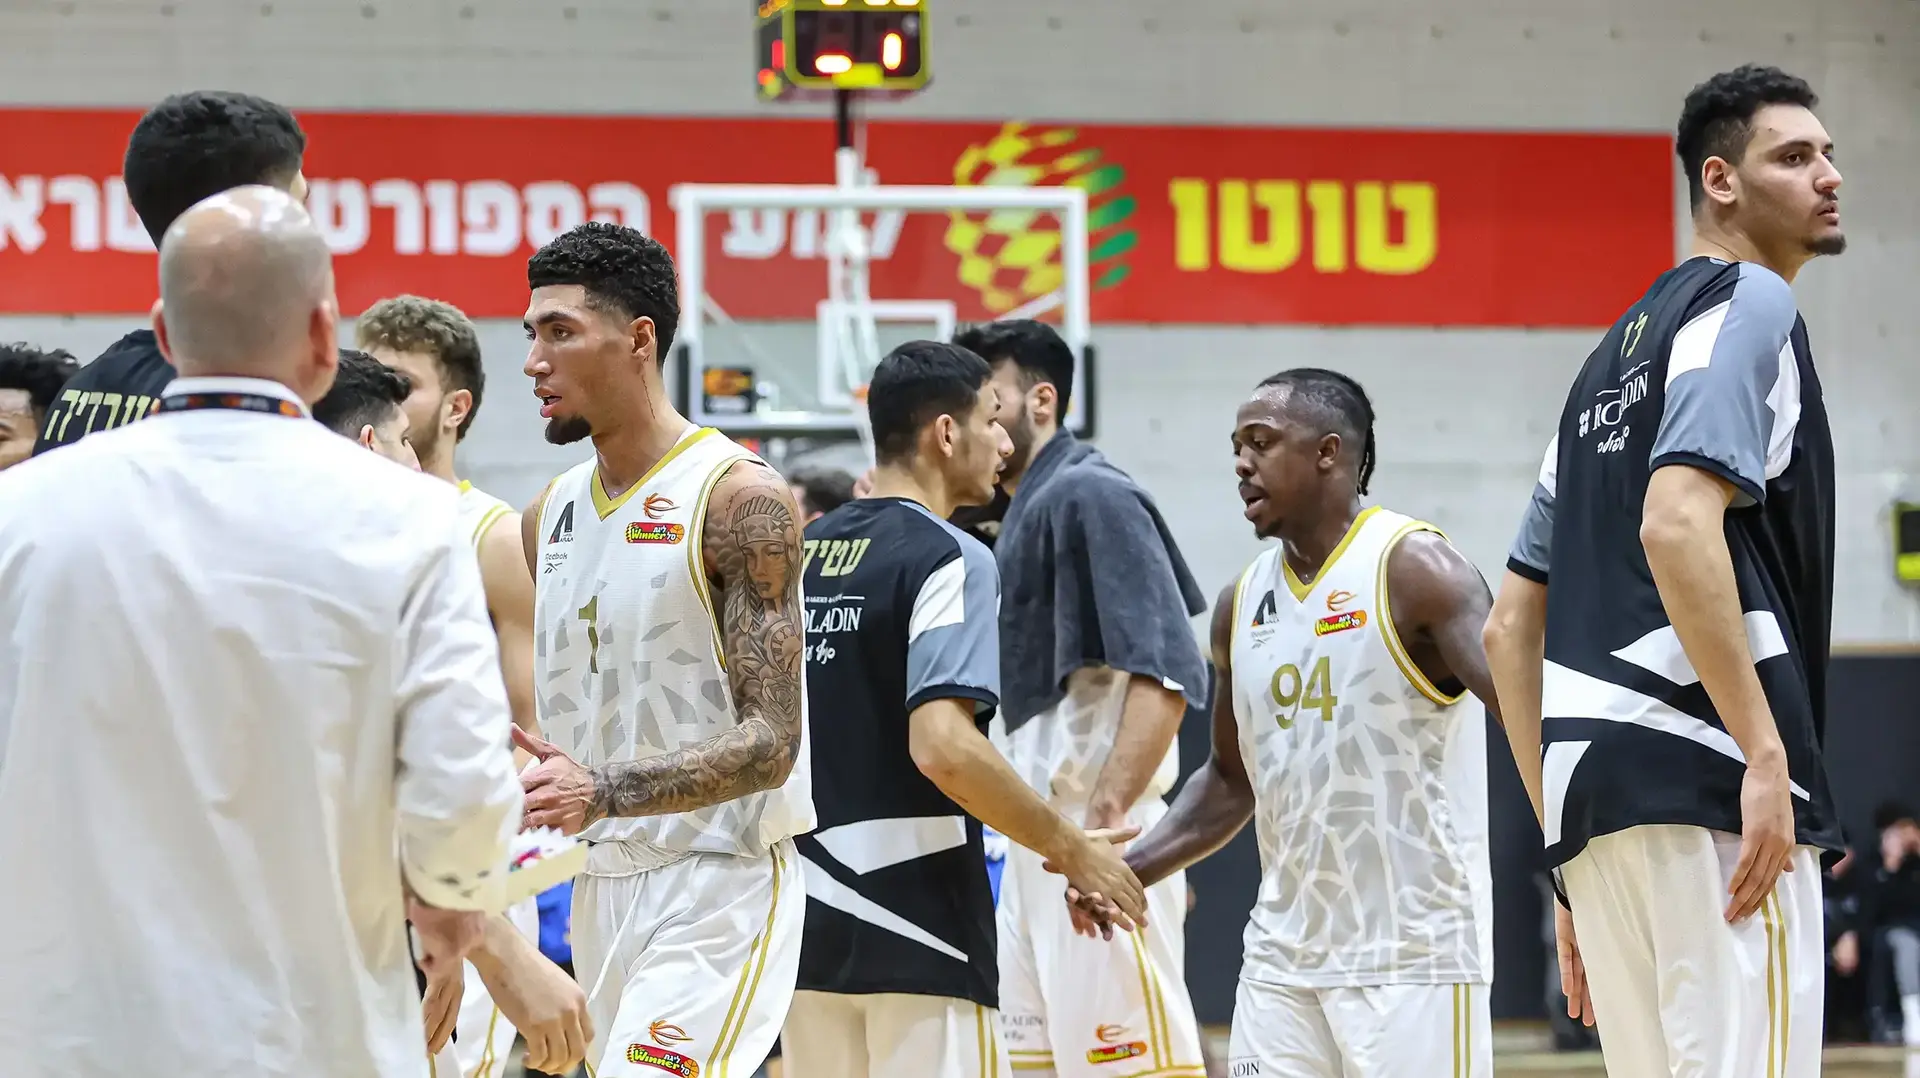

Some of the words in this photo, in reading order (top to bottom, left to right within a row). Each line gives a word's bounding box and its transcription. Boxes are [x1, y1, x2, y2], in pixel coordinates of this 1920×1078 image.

[1168, 179, 1437, 275] טוטו
[631, 526, 666, 540] Winner
[578, 595, 599, 674] 1
[1271, 656, 1338, 730] 94
[634, 1048, 680, 1070] Winner
